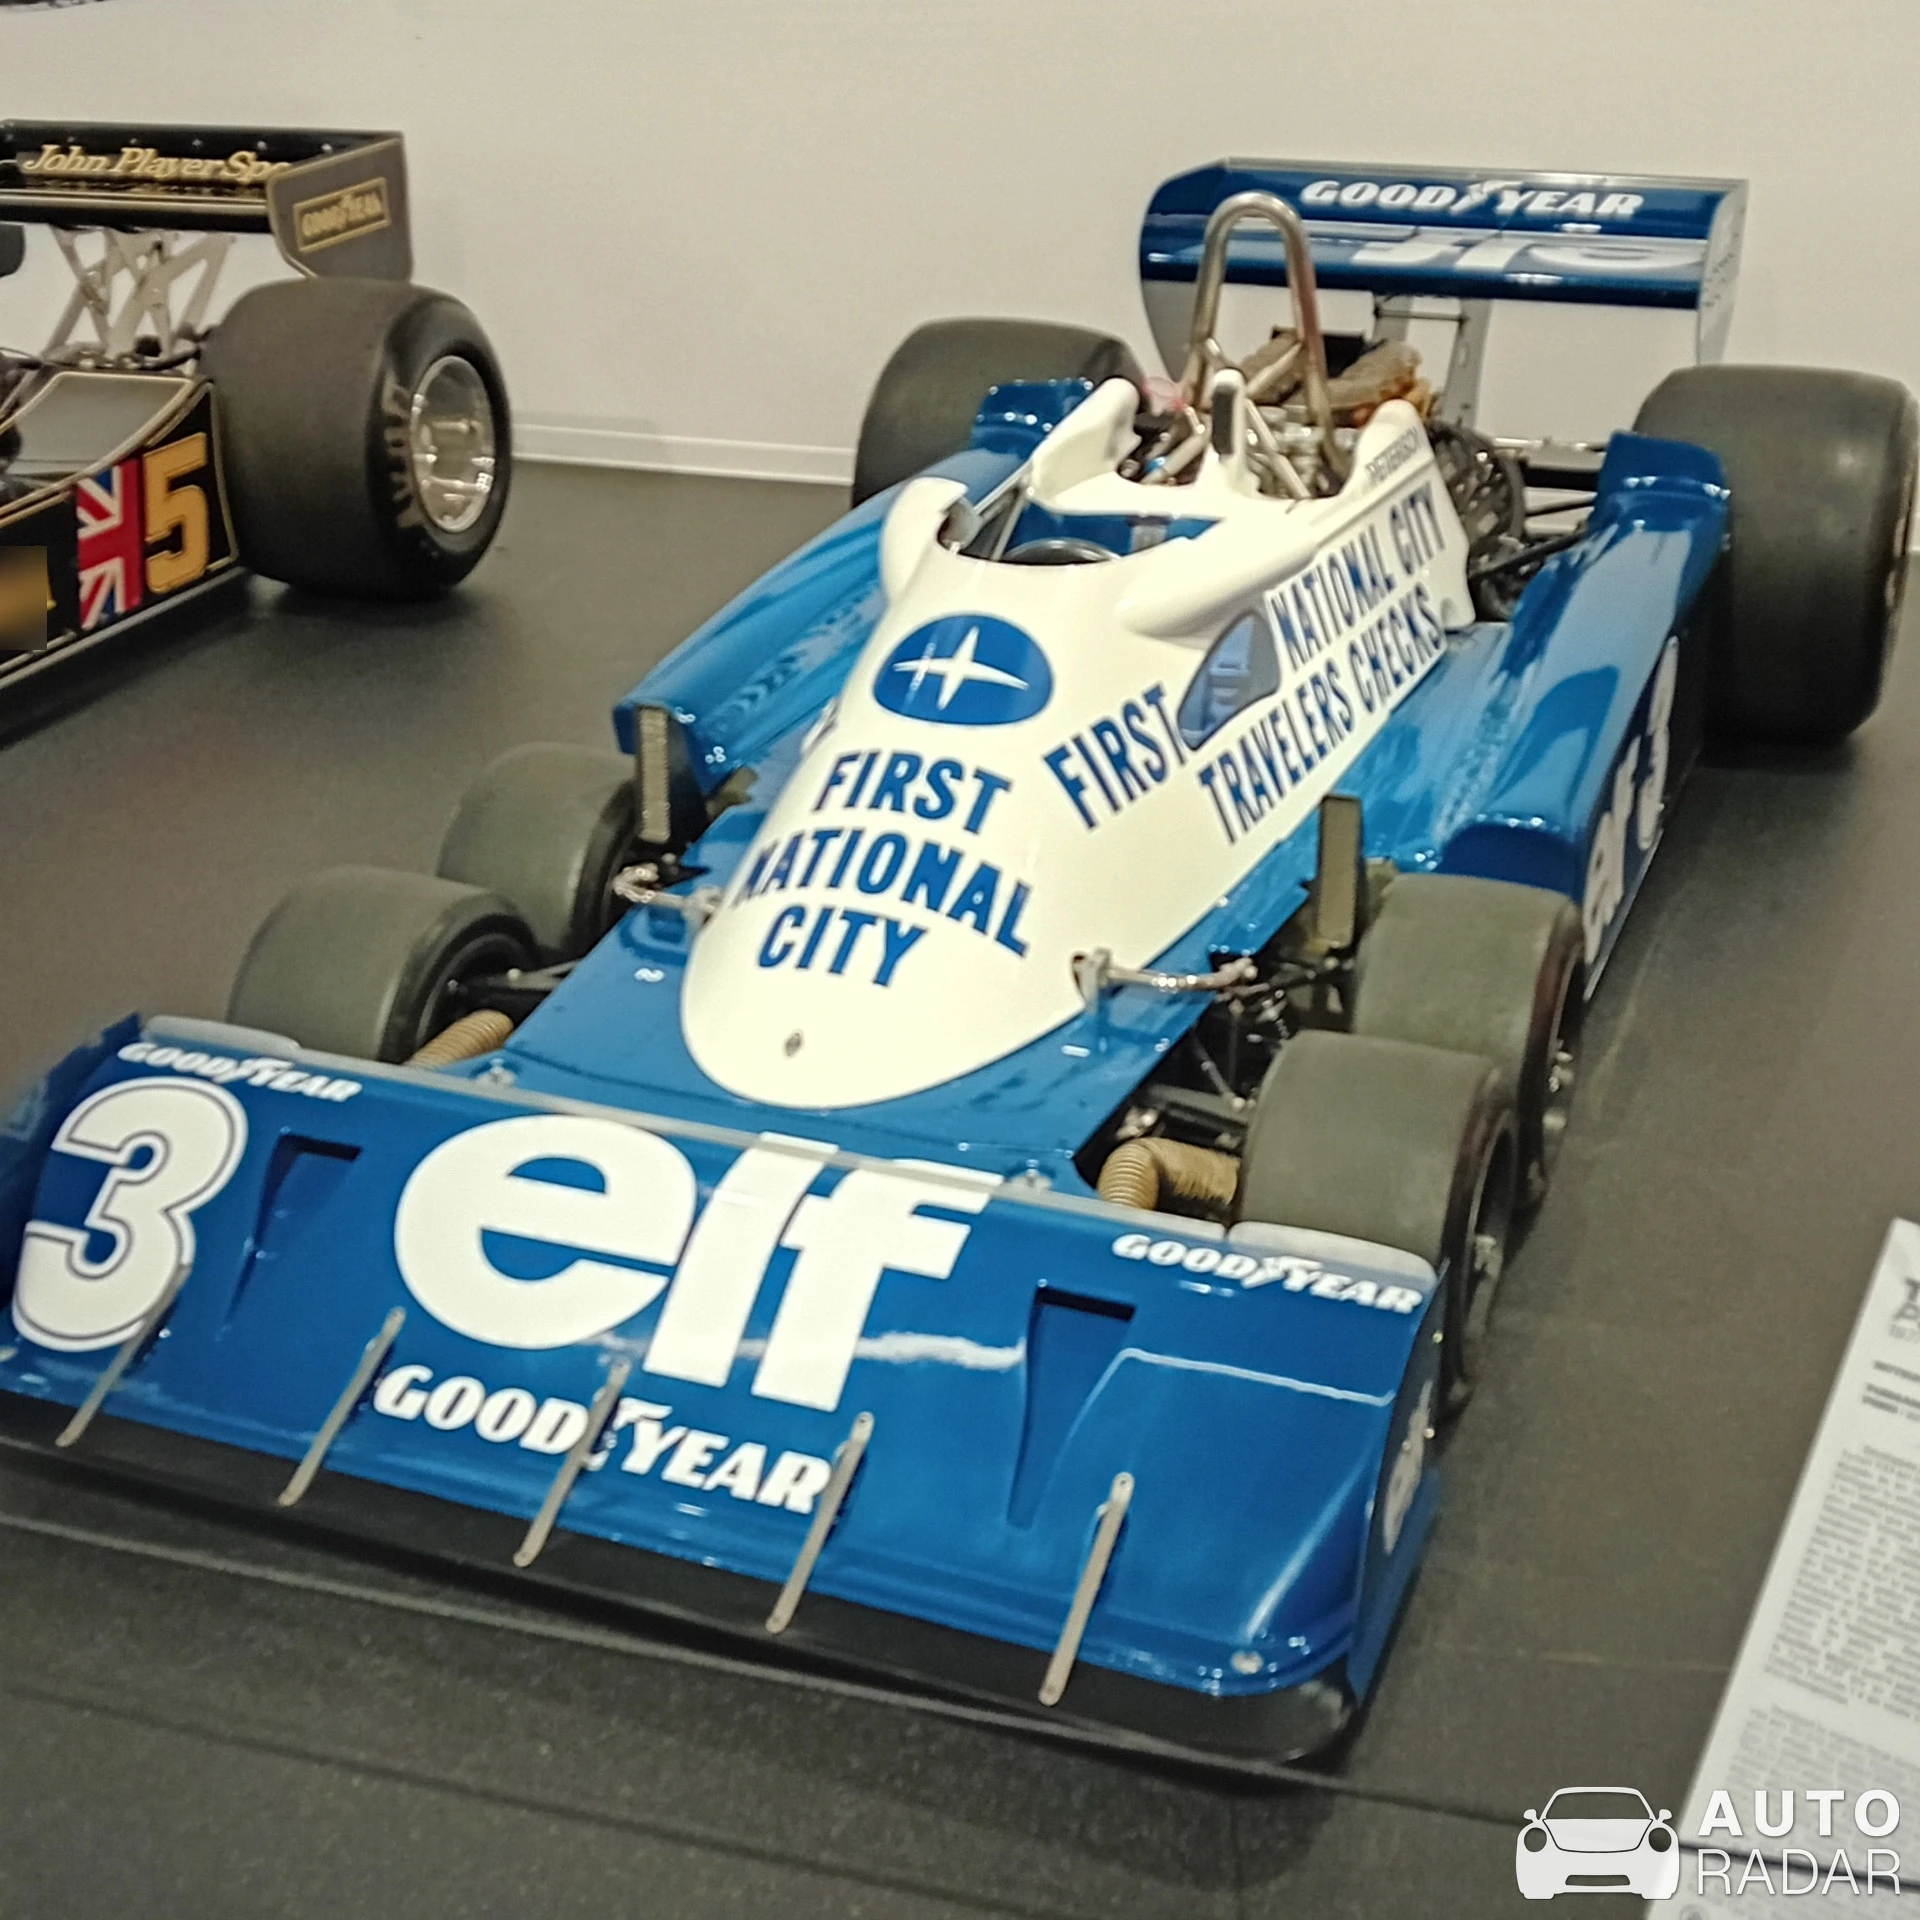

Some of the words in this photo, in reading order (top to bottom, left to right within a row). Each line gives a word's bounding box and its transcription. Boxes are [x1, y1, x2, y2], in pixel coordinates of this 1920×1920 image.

[24, 144, 109, 172] John
[109, 147, 222, 179] Player
[143, 432, 209, 594] 5
[1042, 683, 1187, 830] FIRST
[1271, 522, 1396, 672] NATIONAL
[1389, 482, 1446, 575] CITY
[1198, 658, 1355, 845] TRAVELERS
[1347, 582, 1442, 712] CHECKS
[813, 748, 1012, 836] FIRST
[745, 826, 1032, 958] NATIONAL
[757, 904, 928, 988] CITY
[117, 1042, 362, 1101] GOODYEAR
[12, 1076, 248, 1351] 3
[394, 1113, 1003, 1412] elf
[1112, 1234, 1423, 1314] GOODYEAR
